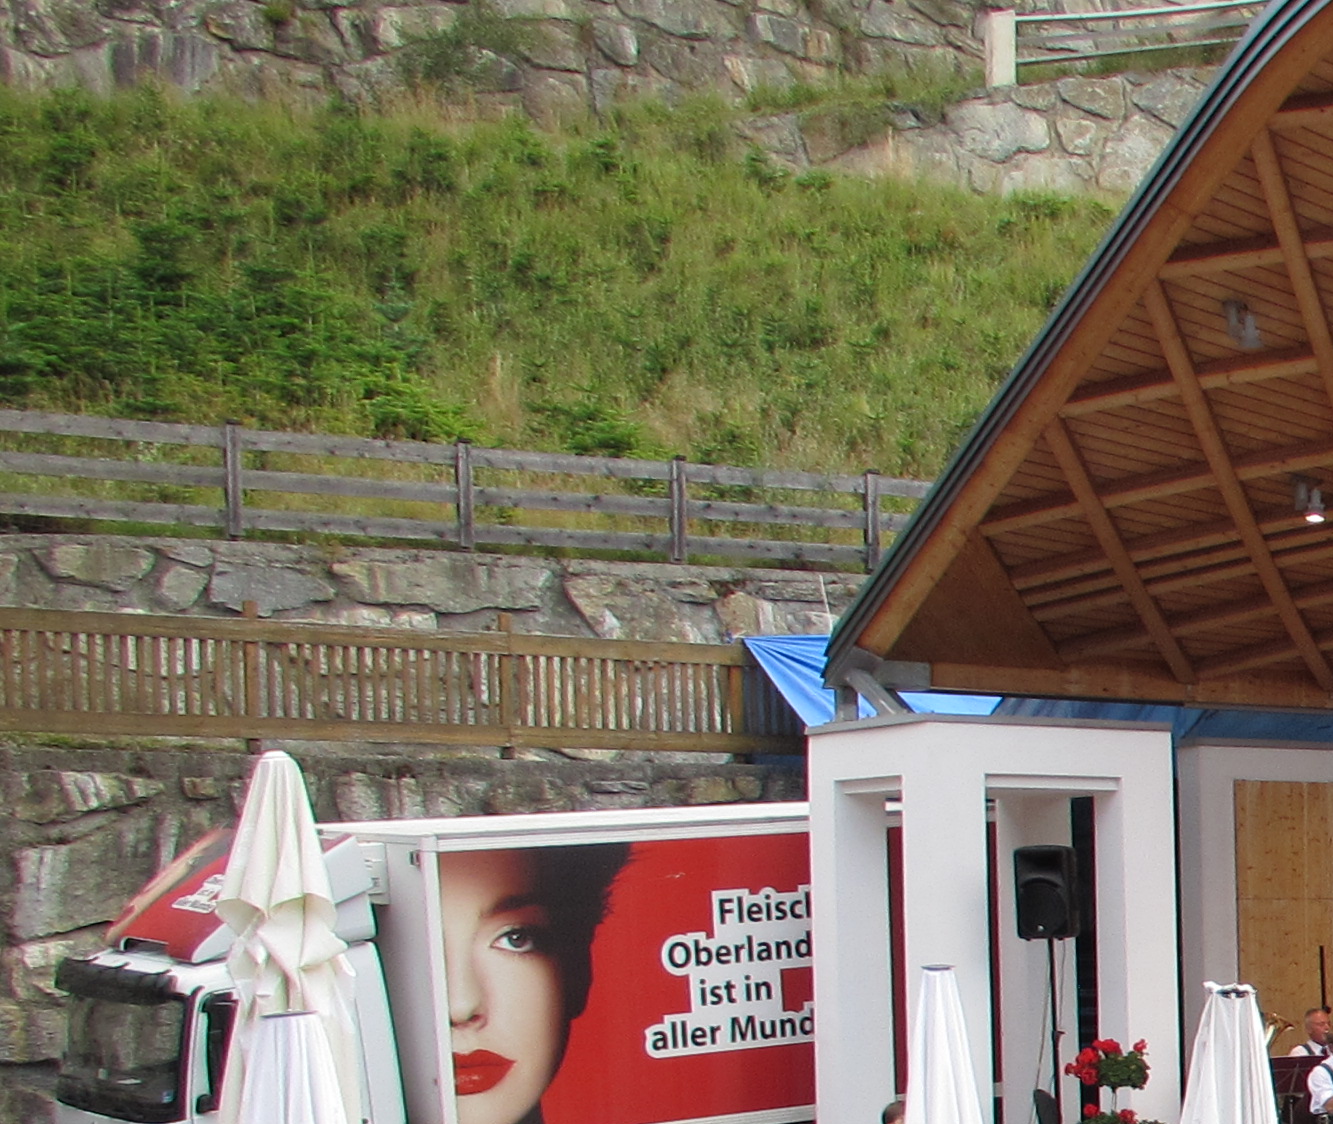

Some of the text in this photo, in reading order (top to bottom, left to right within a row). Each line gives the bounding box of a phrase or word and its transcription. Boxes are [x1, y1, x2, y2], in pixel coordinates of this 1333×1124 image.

[699, 974, 772, 1006] ist in
[651, 1020, 721, 1051] aller
